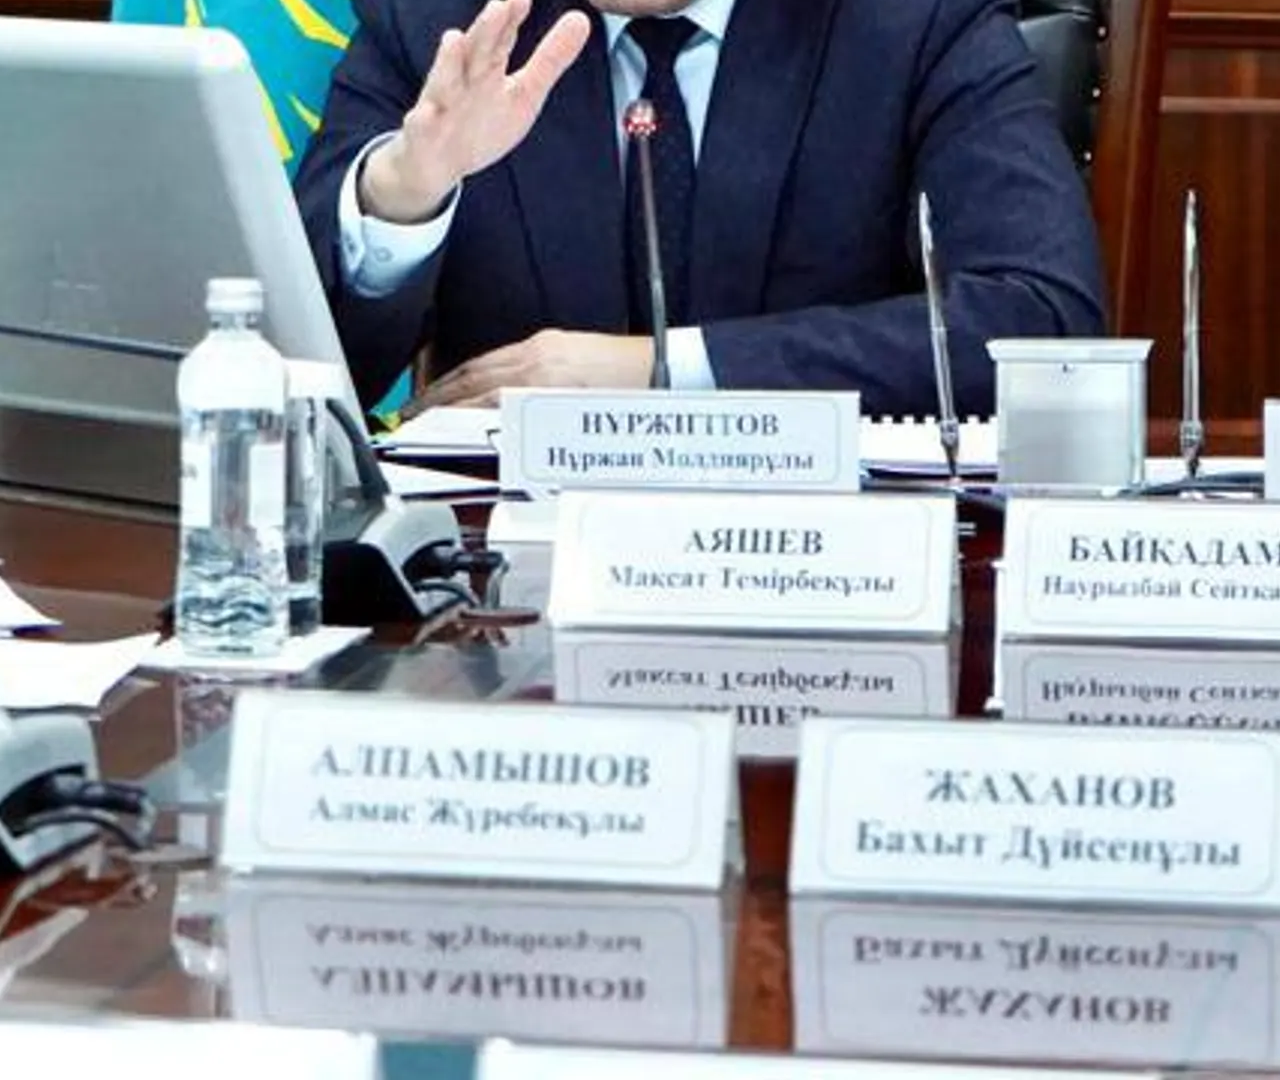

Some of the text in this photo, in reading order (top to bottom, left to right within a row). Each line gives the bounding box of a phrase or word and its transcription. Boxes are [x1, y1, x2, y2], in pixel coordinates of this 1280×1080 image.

[684, 528, 824, 555] АЯШЕВ
[310, 745, 651, 788] АЛПАМЫШОВ
[925, 768, 1177, 811] ЖАХАНОВ
[309, 795, 416, 824] Алмас
[856, 820, 987, 857] Бахыт
